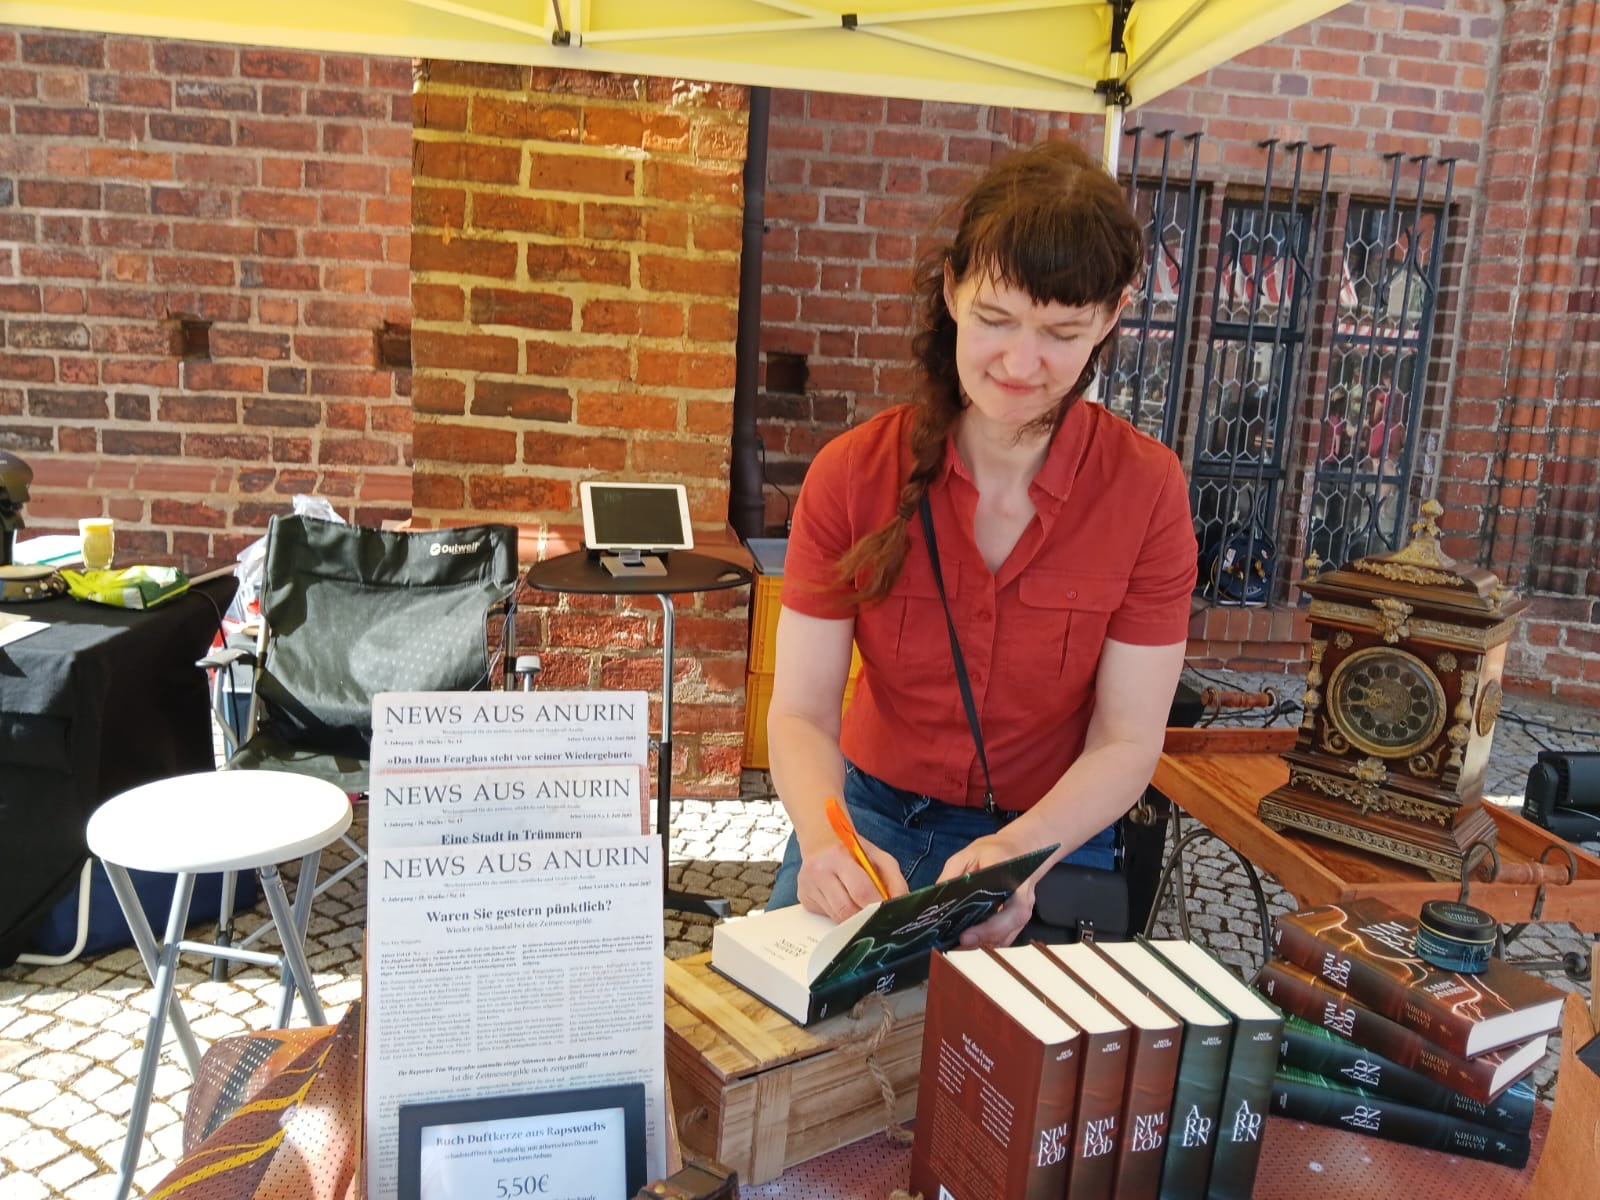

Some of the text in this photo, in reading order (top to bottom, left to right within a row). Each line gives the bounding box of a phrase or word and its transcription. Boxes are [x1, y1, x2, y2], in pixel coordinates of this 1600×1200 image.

[386, 703, 635, 725] NEWS AUS ANURIN
[415, 755, 441, 765] Haus
[490, 753, 513, 763] steht
[516, 753, 531, 761] vor
[534, 751, 562, 761] seiner
[385, 778, 630, 806] NEWS AUS ANURIN
[441, 829, 582, 846] Eine Stadt in Trümmern
[383, 846, 650, 880] NEWS AUS ANURIN
[426, 900, 612, 923] Waren Sie gestern pünktlich?
[446, 925, 470, 935] Wieder
[485, 921, 513, 931] Skandal
[514, 920, 525, 929] bei
[526, 919, 538, 929] der
[1322, 952, 1336, 976] NIM
[1338, 959, 1352, 988] LOD
[1323, 1001, 1338, 1026] NIM
[1342, 1008, 1356, 1037] LOD
[462, 1072, 474, 1080] die
[531, 1065, 549, 1074] noch
[1366, 1063, 1382, 1087] EN
[1085, 1116, 1114, 1136] NIM
[1135, 1112, 1165, 1131] NIM
[1185, 1117, 1211, 1133] RD
[1235, 1112, 1261, 1129] RD
[1366, 1107, 1382, 1131] EN
[436, 1121, 606, 1146] Buch Duftkerze aus Rapswachs
[1040, 1122, 1068, 1144] NIM
[1131, 1135, 1163, 1152] LOD
[1181, 1131, 1210, 1147] EN
[1231, 1127, 1260, 1143] EN
[1036, 1147, 1066, 1168] LOD
[1082, 1137, 1113, 1158] LOD
[496, 1173, 550, 1200] 5,50€
